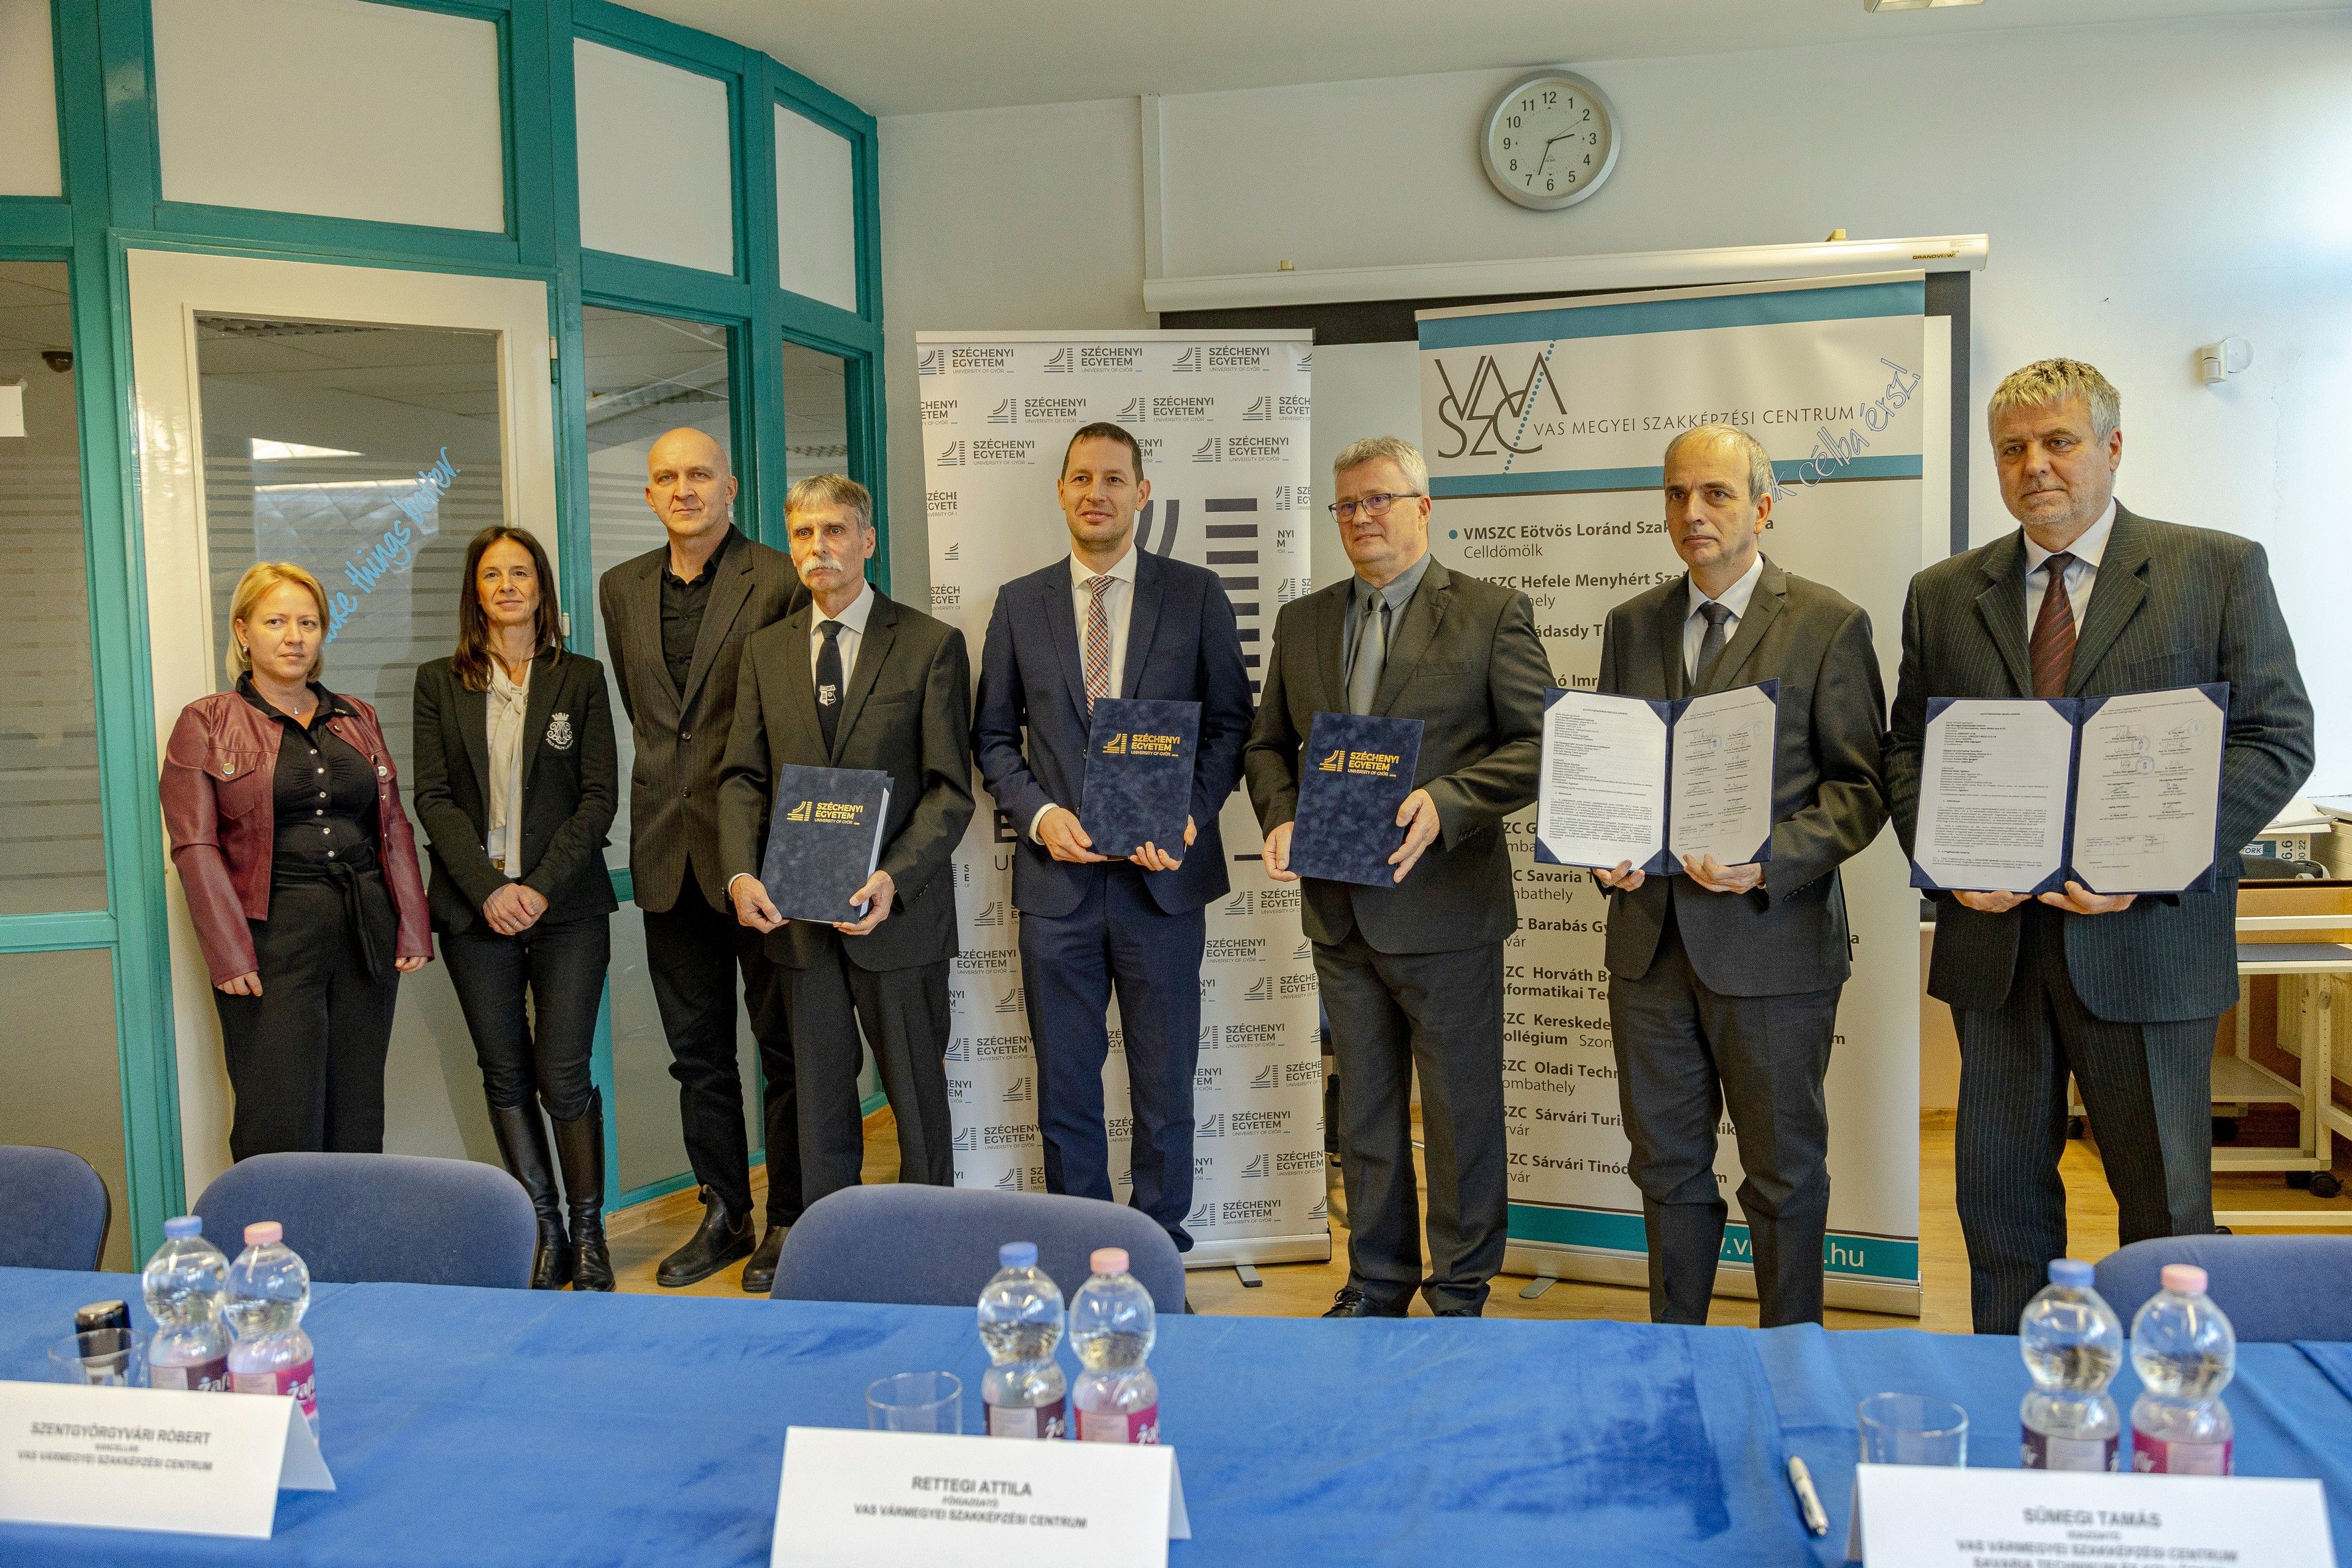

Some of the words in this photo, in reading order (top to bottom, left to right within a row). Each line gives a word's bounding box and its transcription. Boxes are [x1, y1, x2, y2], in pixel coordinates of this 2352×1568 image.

[1542, 92, 1557, 104] 12
[1568, 97, 1573, 109] 1
[1522, 100, 1535, 112] 11
[1583, 109, 1590, 121] 2
[1506, 116, 1521, 128] 10
[1503, 137, 1510, 149] 9
[1589, 133, 1597, 145] 3
[1510, 159, 1517, 171] 8
[1583, 154, 1591, 165] 4
[1526, 174, 1532, 186] 7
[1569, 171, 1575, 183] 5
[1547, 179, 1554, 191] 6
[952, 347, 1014, 357] SZÉCHENYI
[1081, 347, 1142, 356] SZÉCHENYI
[1209, 345, 1269, 356] SZÉCHENYI
[953, 358, 1004, 368] EGYETEM
[1081, 358, 1133, 366] EGYETEM
[920, 400, 957, 409] CHENYI
[1024, 397, 1086, 408] SZÉCHENYI
[1153, 396, 1214, 406] SZÉCHENYI
[1279, 395, 1310, 405] SZÉCH
[921, 410, 948, 419] ETEM
[1025, 408, 1076, 417] EGYETEM
[1153, 407, 1204, 416] EGYETEM
[1279, 406, 1310, 415] EGYET
[1534, 422, 1565, 436] VAS
[1573, 418, 1635, 434] MEGYEI
[1643, 409, 1755, 431] SZAKKÉPZÉSI
[1763, 406, 1853, 424] CENTRUM
[973, 439, 1035, 449] SZÉCHENYI
[1229, 435, 1289, 446] SZÉCHENYI
[973, 450, 1025, 459] EGYETEM
[1229, 447, 1279, 455] EGYETEM
[1464, 526, 1517, 540] VMSZC
[1521, 524, 1572, 538] Eötvös
[1577, 522, 1632, 536] Loránd
[1636, 520, 1669, 534] Szak
[343, 520, 411, 593] things
[1464, 543, 1543, 559] Celldömölk
[1522, 574, 1570, 588] Hefele
[1575, 572, 1650, 589] Menyhért
[931, 584, 960, 593] SZÉCH
[931, 595, 959, 604] EGYET
[1536, 625, 1589, 640] ádasdy
[1573, 674, 1598, 687] Imr
[1133, 733, 1180, 744] SZÉCHENYI
[1131, 742, 1172, 751] EGYETEM
[1350, 751, 1399, 763] SZÉCHENYI
[1348, 760, 1390, 771] EGYETEM
[817, 802, 863, 813] SZÉCHENYI
[815, 810, 854, 820] EGYETEM
[1528, 869, 1582, 883] Savaria
[1261, 888, 1300, 899] SZÉCHE
[1514, 887, 1573, 903] bathely
[1261, 899, 1300, 908] EGYETE
[1529, 916, 1587, 932] Barabás
[1206, 938, 1266, 948] SZÉCHENYI
[957, 949, 1016, 959] SZÉCHENYI
[1206, 949, 1256, 957] EGYETEM
[957, 959, 1007, 968] EGYETEM
[1281, 973, 1318, 984] SZÉCHE
[1533, 967, 1593, 981] Horváth
[1534, 1014, 1610, 1030] Kereskede
[1225, 1023, 1285, 1034] SZÉCHENYI
[977, 1035, 1032, 1047] SZÉCHENY
[1226, 1033, 1275, 1042] EGYETEM
[1504, 1030, 1568, 1046] ollégium
[977, 1045, 1028, 1056] EGYETEM
[1286, 1061, 1322, 1072] SZÉCHE
[1535, 1061, 1573, 1076] Oladi
[1578, 1065, 1618, 1079] Techn
[1286, 1071, 1322, 1081] EGYETE
[1503, 1077, 1575, 1096] ombathely
[1232, 1110, 1290, 1121] SZÉCHENYI
[1535, 1107, 1587, 1123] Sárvári
[984, 1124, 1039, 1135] SZÉCHENY
[1232, 1120, 1281, 1130] EGYETEM
[984, 1134, 1034, 1144] EGYETEM
[1277, 1150, 1324, 1162] SZÉCHEN
[1532, 1154, 1583, 1170] Sárvári
[1588, 1160, 1629, 1175] Tinód
[1223, 1200, 1281, 1210] SZÉCHENYI
[1223, 1210, 1272, 1219] EGYETEM
[911, 1475, 976, 1494] RETTEGI
[979, 1480, 1033, 1497] ATTILA
